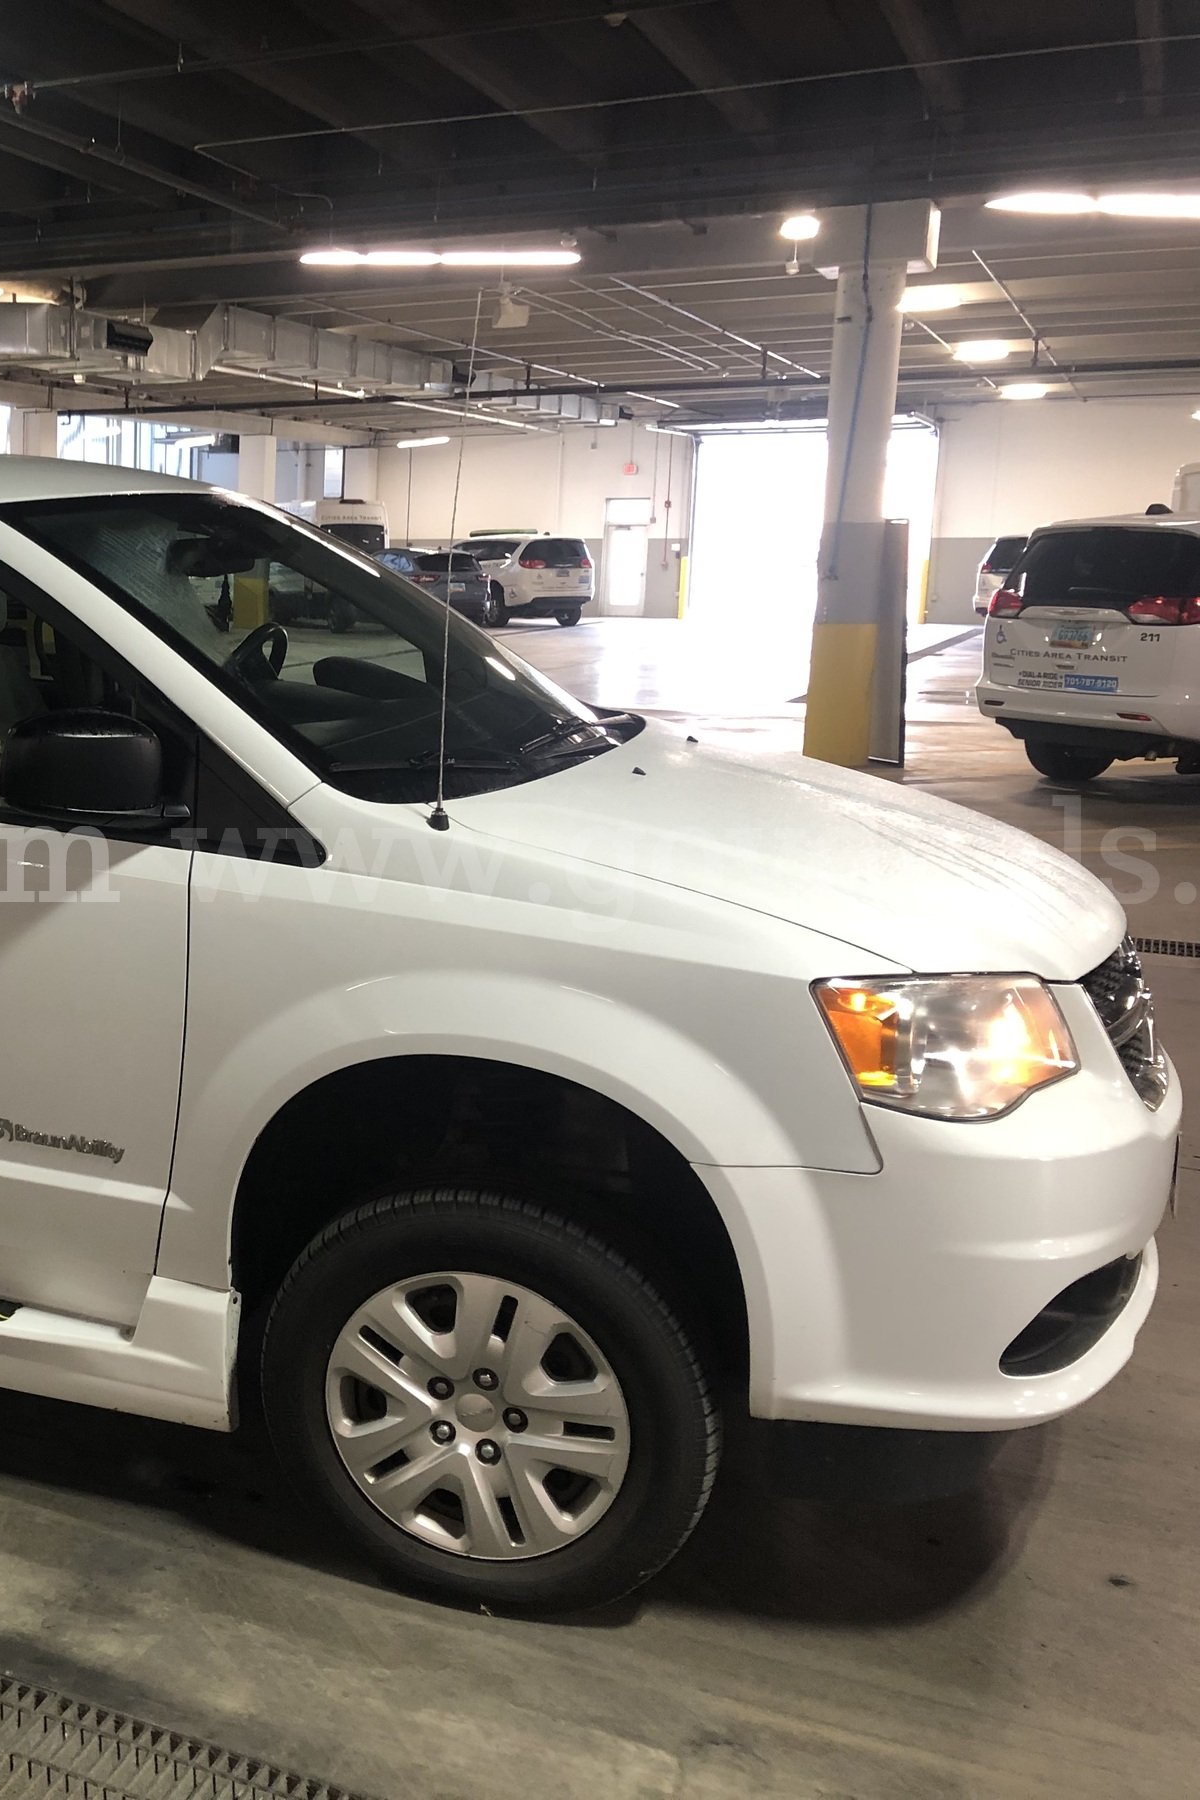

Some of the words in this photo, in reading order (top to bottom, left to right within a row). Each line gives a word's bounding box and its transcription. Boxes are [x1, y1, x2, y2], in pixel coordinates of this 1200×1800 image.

[1140, 632, 1161, 642] 211
[1010, 648, 1040, 658] CITIES
[1043, 650, 1072, 660] AREA
[1076, 652, 1128, 662] TRANSIT
[14, 1123, 126, 1165] BraunAbility
